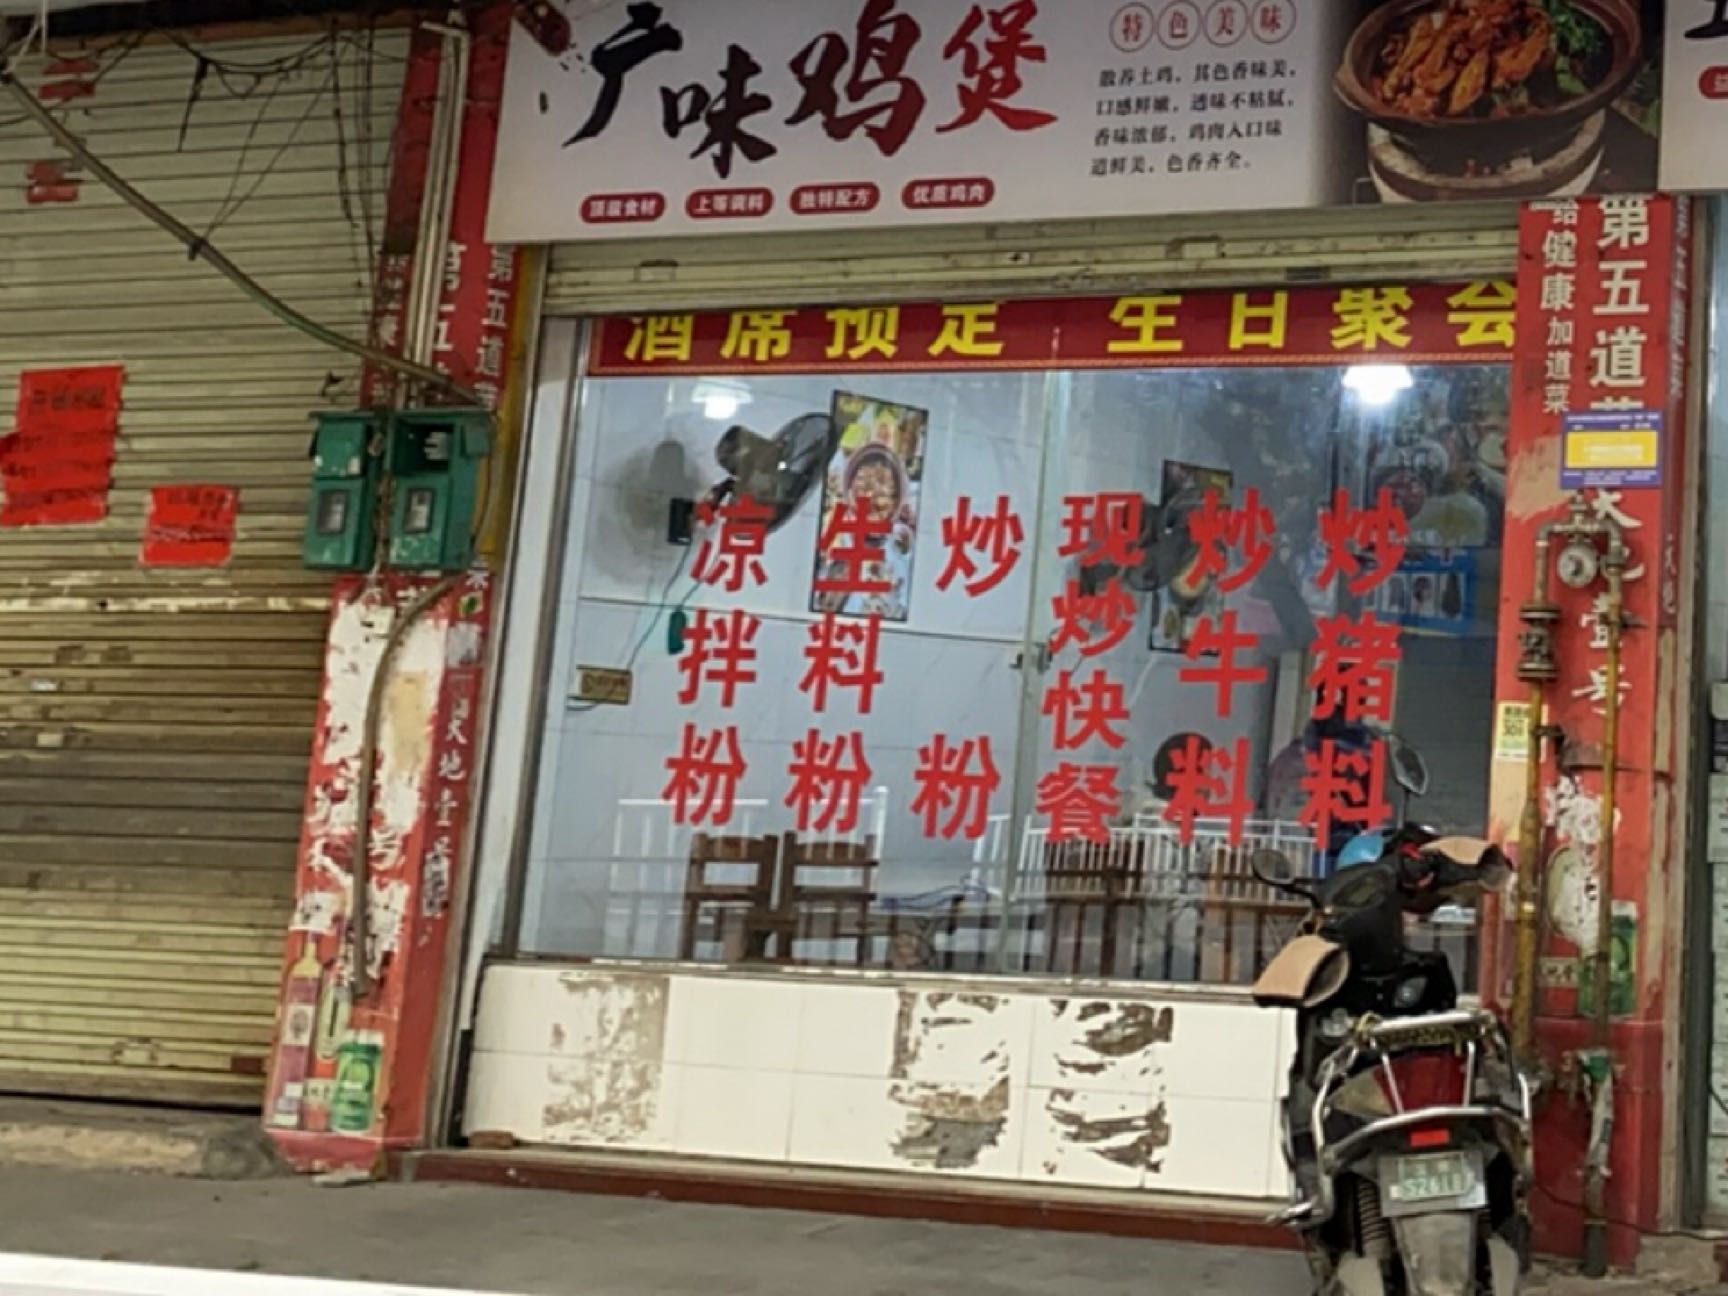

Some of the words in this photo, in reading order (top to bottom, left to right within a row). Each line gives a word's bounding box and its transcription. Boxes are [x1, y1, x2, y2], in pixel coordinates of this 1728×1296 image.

[1119, 2, 1286, 45] 特色美味
[1106, 280, 1517, 352] 生日聚会
[661, 493, 776, 827] 凉拌粉
[785, 495, 893, 835] 生料粉
[1036, 491, 1147, 845] 现炒快餐
[1163, 486, 1277, 849] 炒牛料
[1299, 486, 1412, 851] 炒猪料
